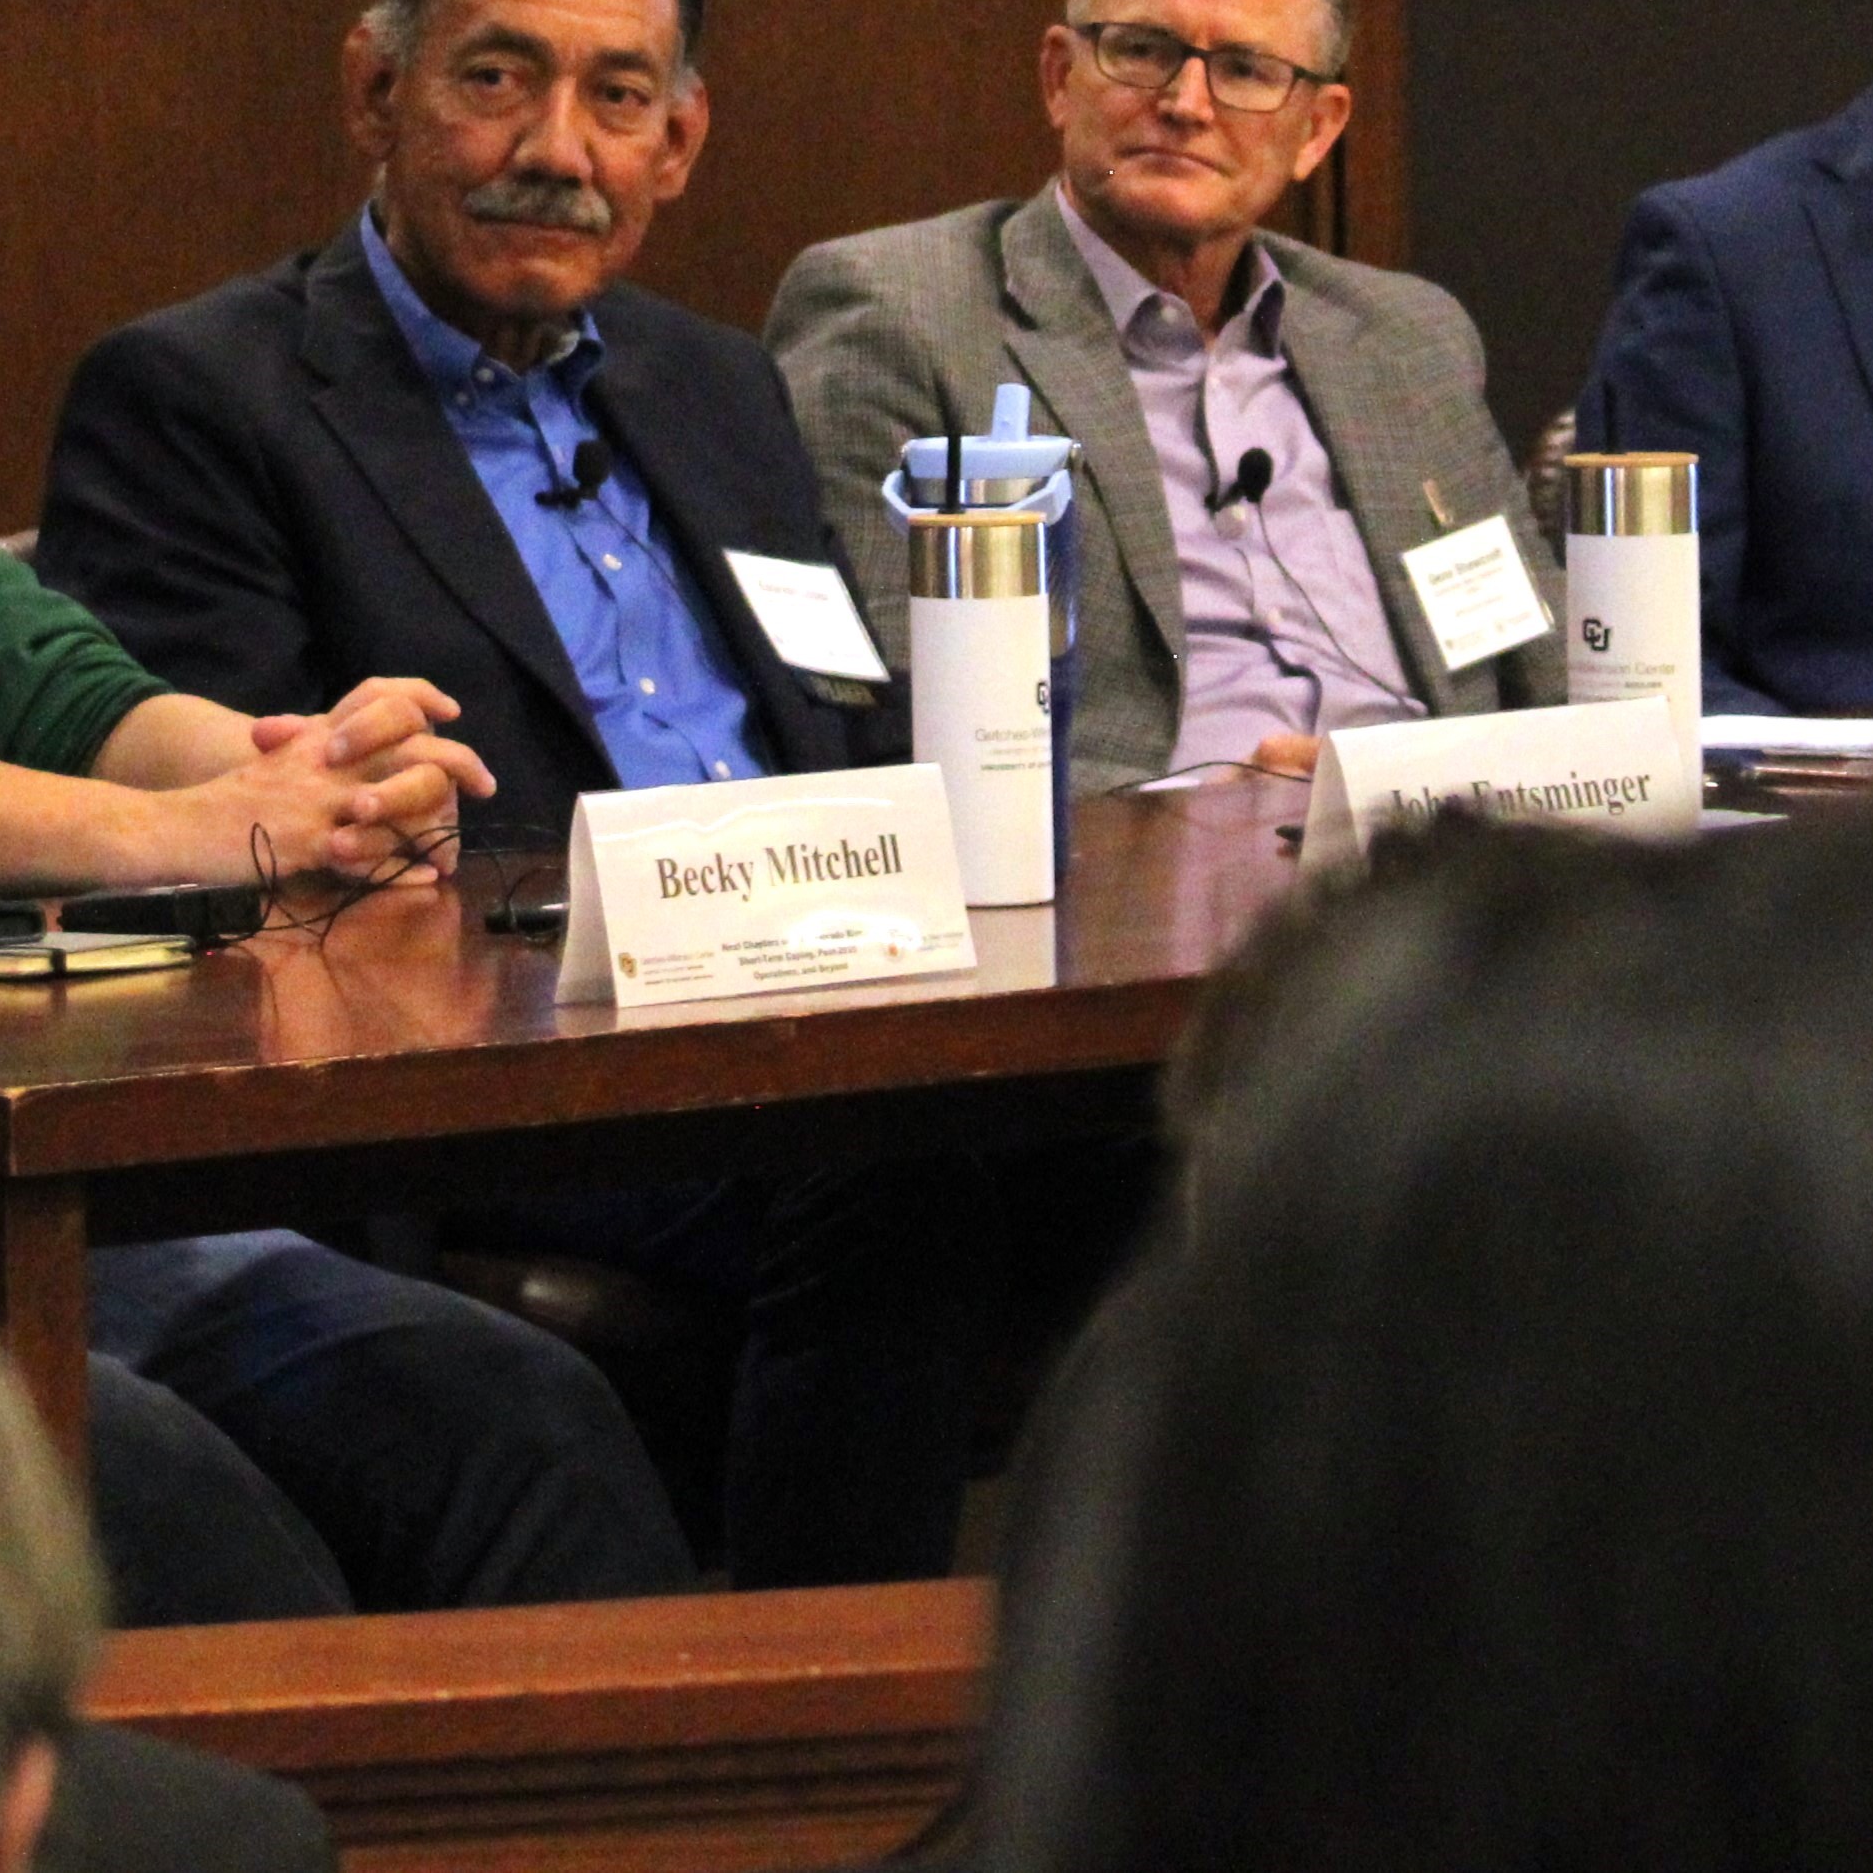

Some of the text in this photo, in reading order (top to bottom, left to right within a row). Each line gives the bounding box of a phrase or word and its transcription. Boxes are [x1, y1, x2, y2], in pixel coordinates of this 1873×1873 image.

[1582, 618, 1611, 652] CU
[1471, 771, 1651, 816] Entsminger
[654, 833, 903, 902] Becky Mitchell
